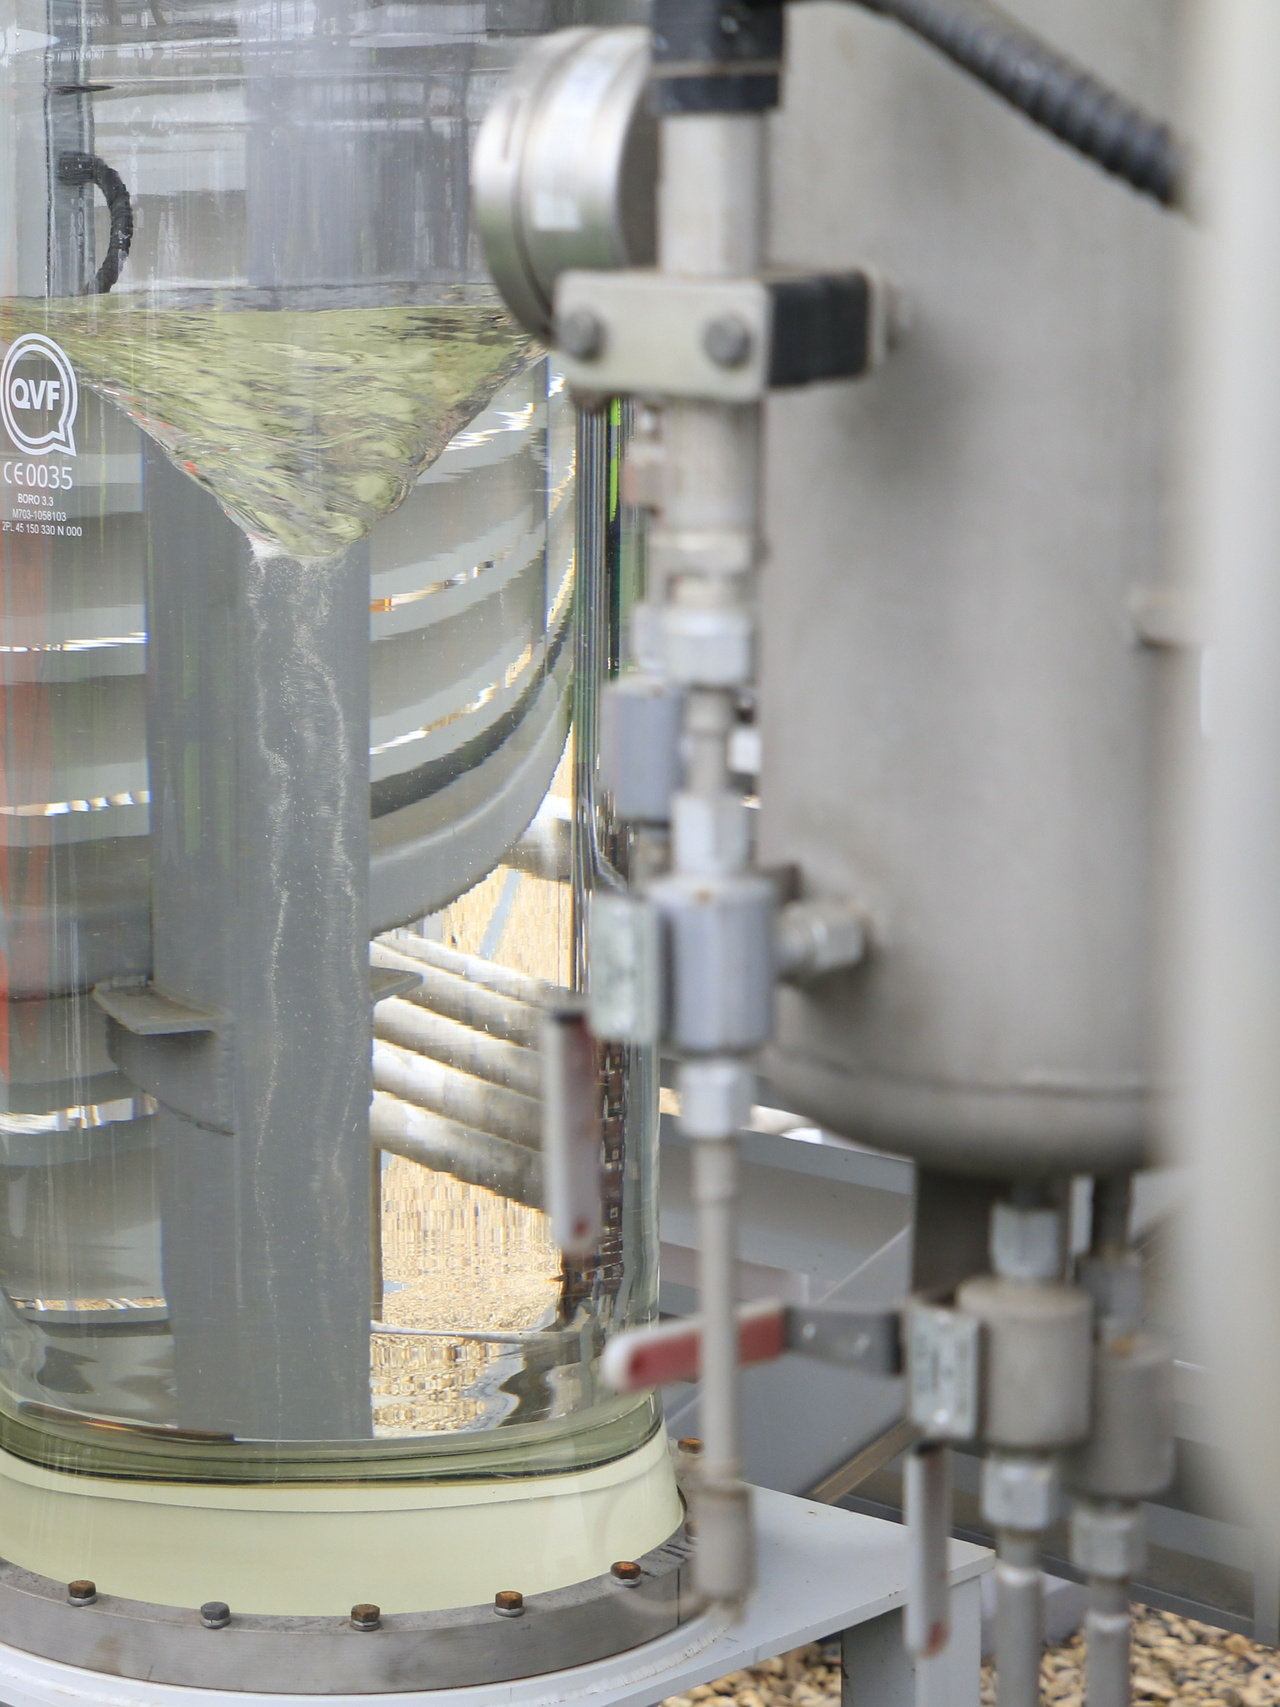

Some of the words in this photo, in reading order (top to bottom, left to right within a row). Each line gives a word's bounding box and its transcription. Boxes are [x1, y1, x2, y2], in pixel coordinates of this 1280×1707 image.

[10, 377, 61, 411] QVF
[17, 493, 41, 505] BORO
[41, 495, 54, 507] 3.3
[12, 508, 67, 522] M703-1058103
[15, 522, 25, 533] 45
[26, 523, 40, 534] 150
[40, 524, 56, 535] 330
[57, 525, 65, 536] N
[66, 526, 83, 537] 000
